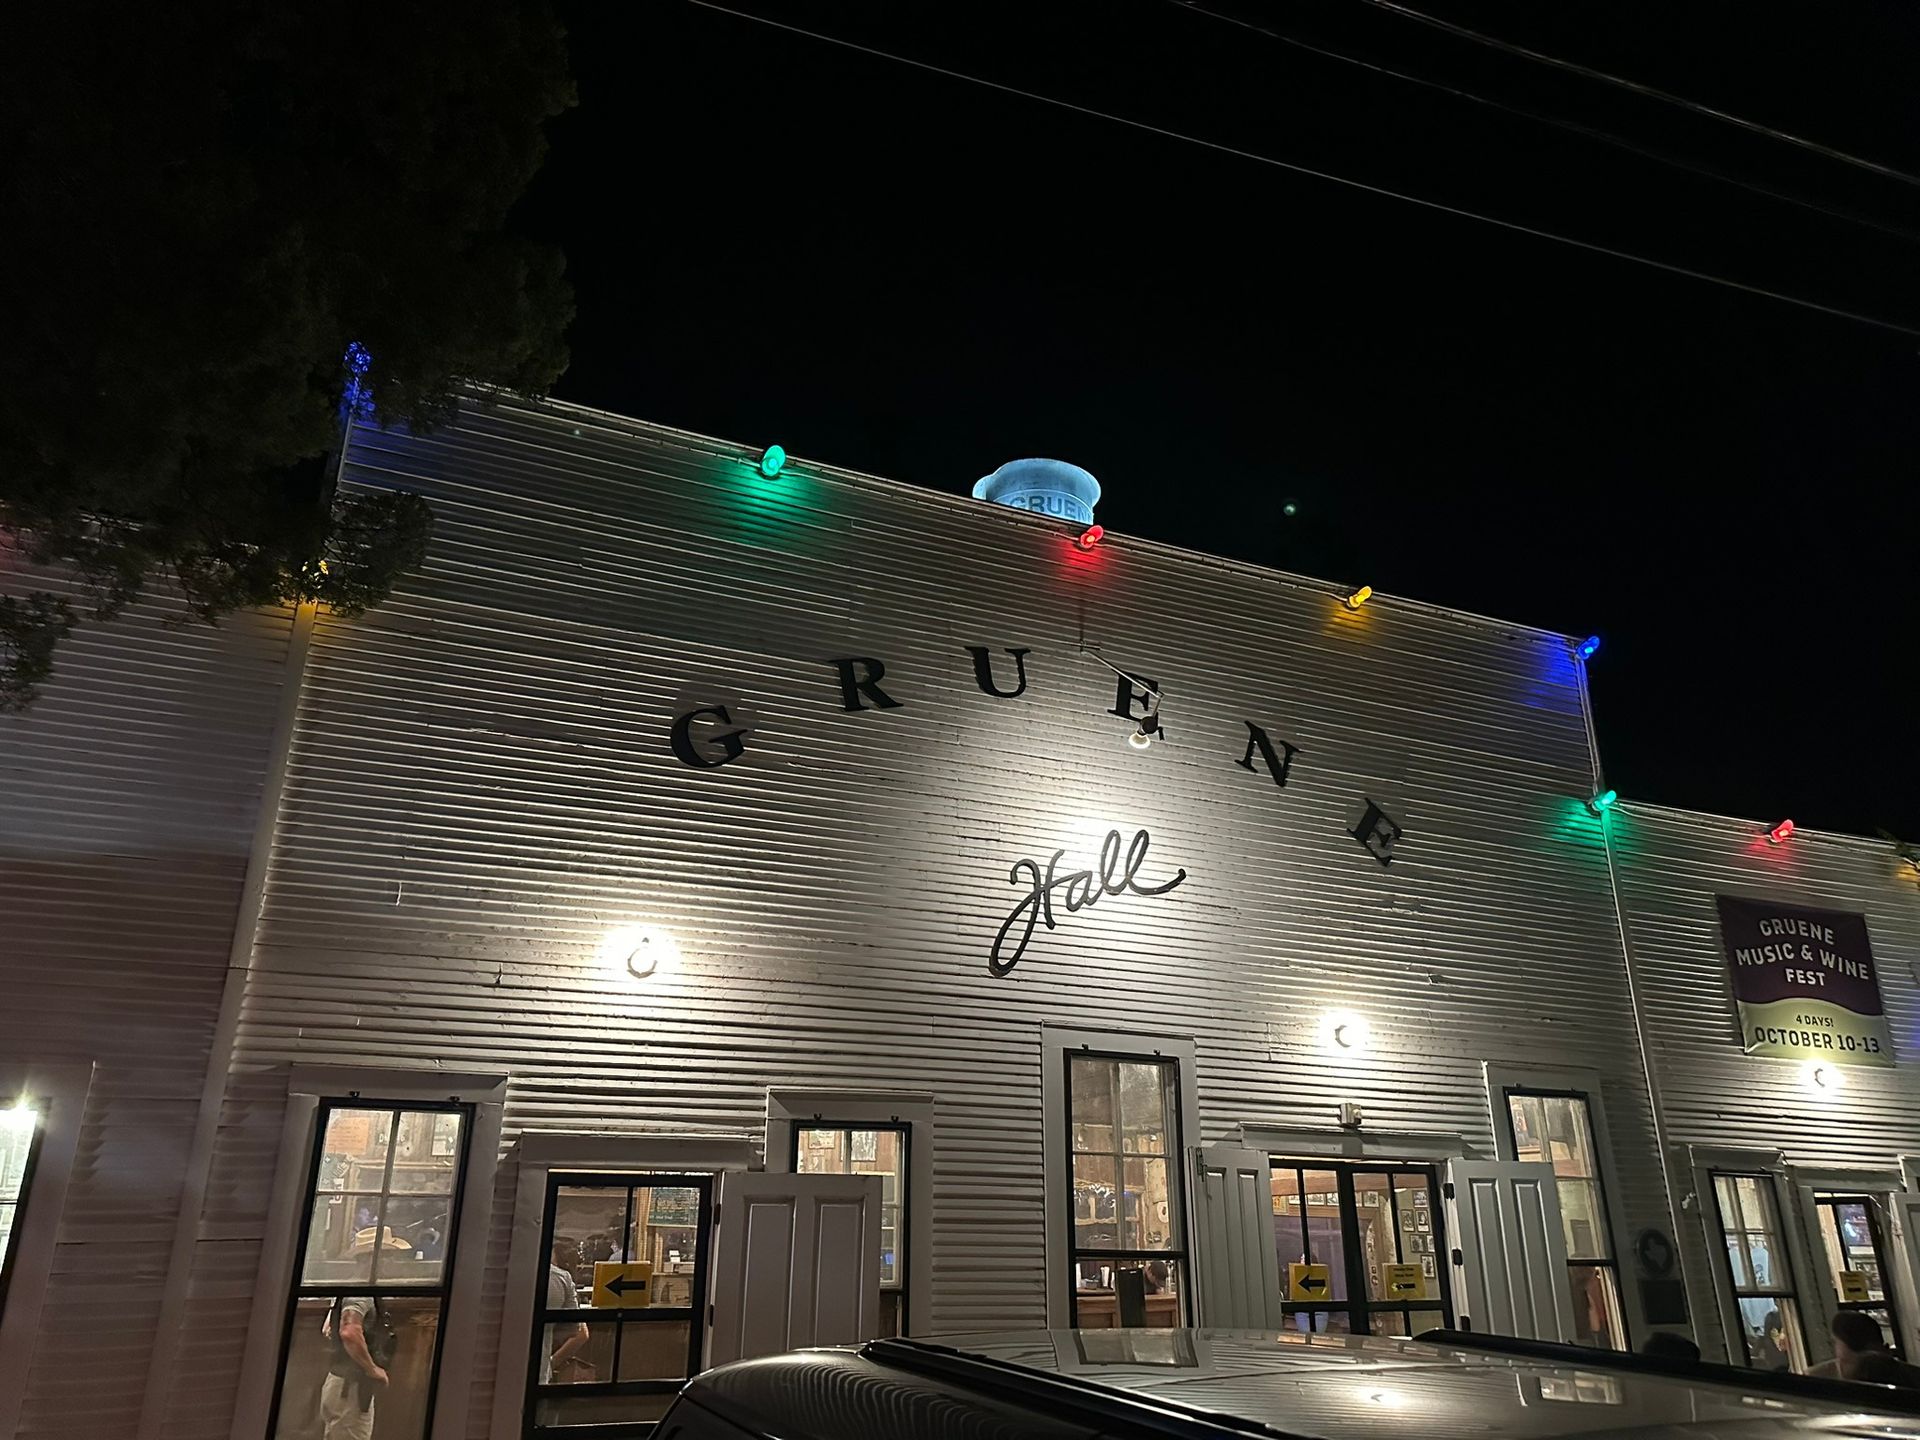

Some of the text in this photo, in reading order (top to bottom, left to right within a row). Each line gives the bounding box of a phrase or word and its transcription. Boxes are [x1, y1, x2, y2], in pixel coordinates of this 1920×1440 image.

[670, 645, 1402, 867] GRUENE
[988, 828, 1187, 978] Hall
[1759, 917, 1835, 945] GRUENE
[1735, 942, 1870, 980] MUSIC & WINE
[1785, 968, 1825, 986] FEST
[1795, 1014, 1834, 1027] 4 DAYS!
[1754, 1027, 1880, 1053] OCTOBER 10-13
